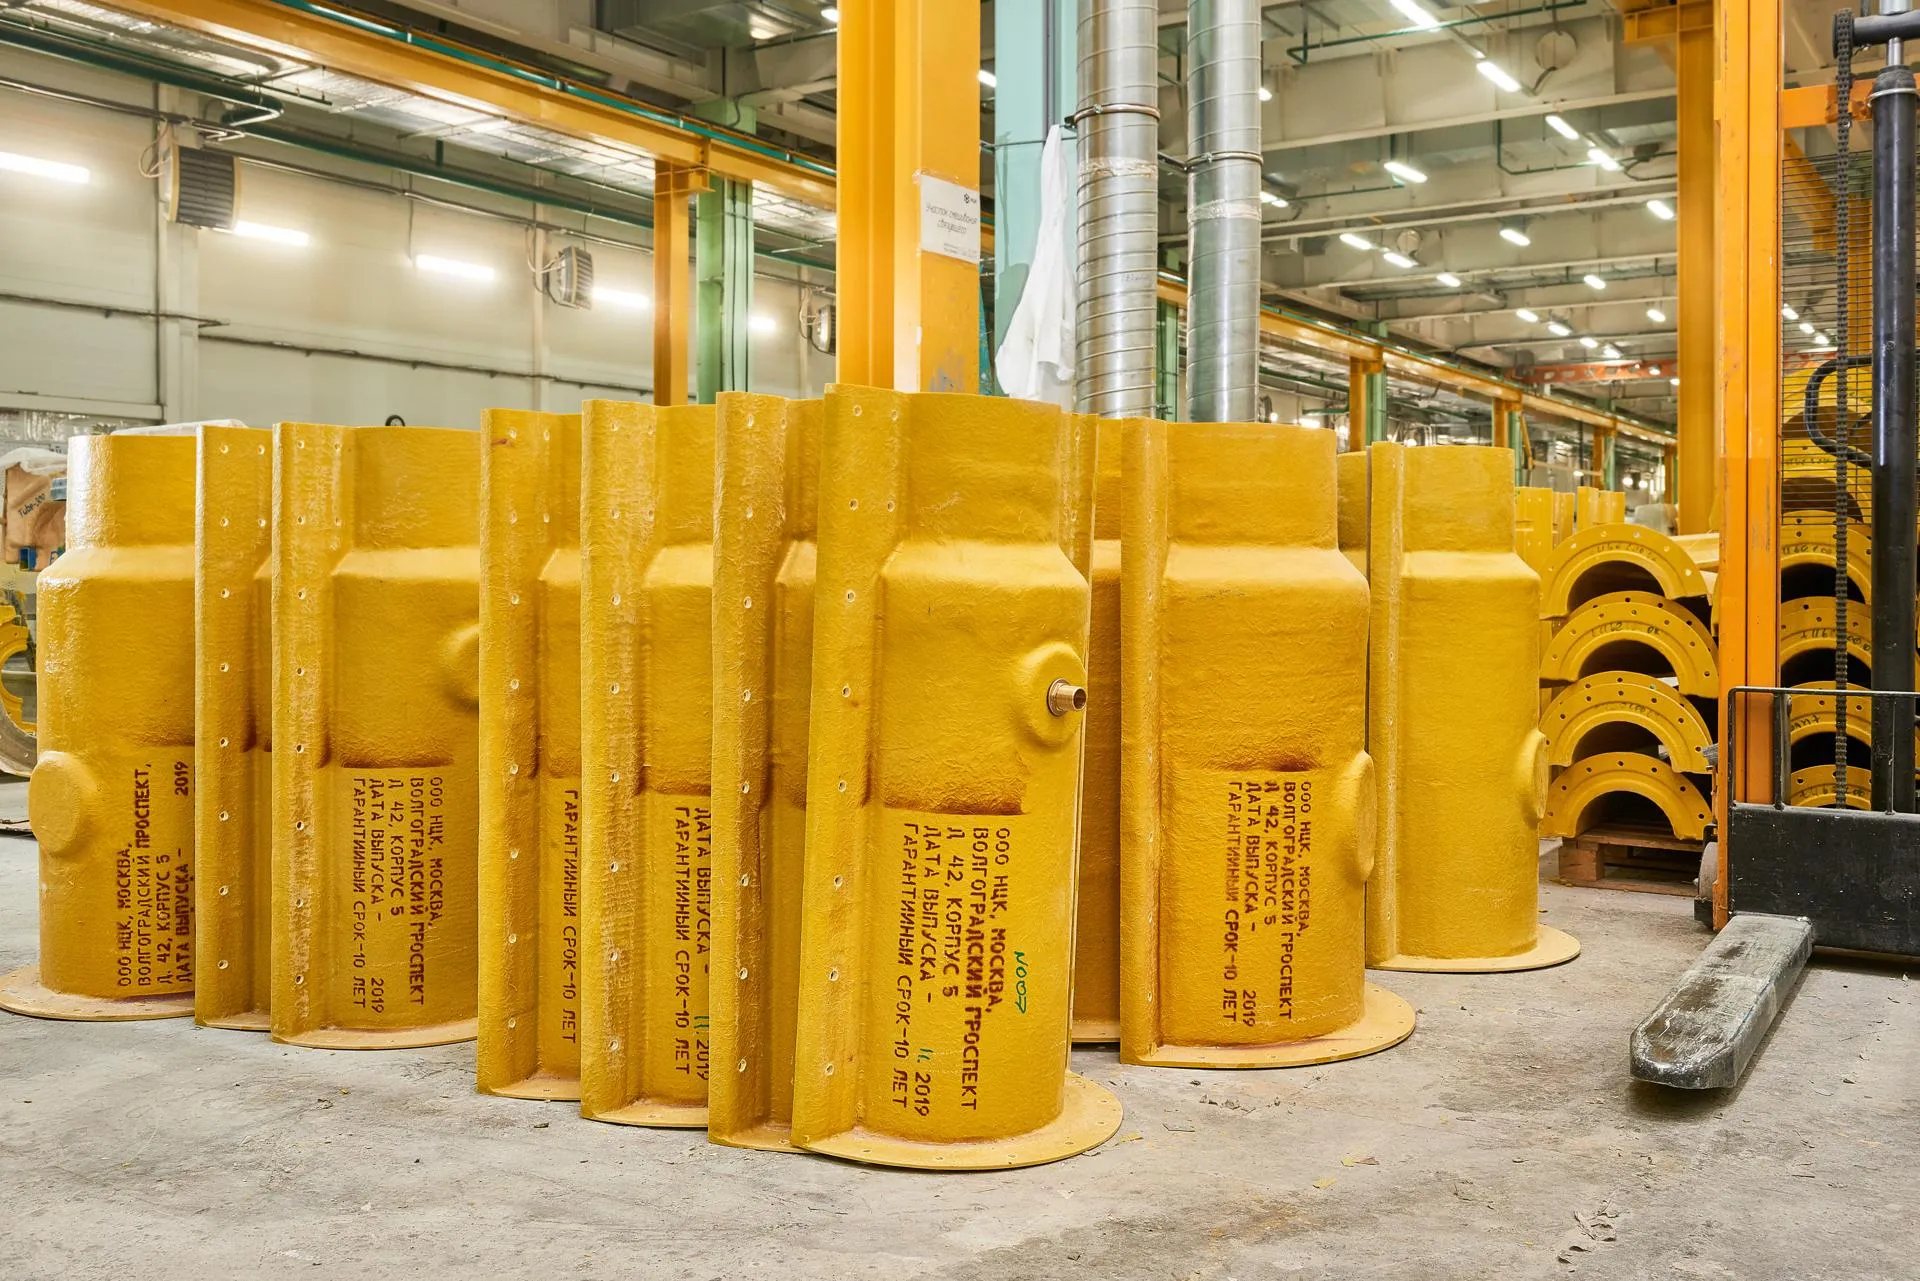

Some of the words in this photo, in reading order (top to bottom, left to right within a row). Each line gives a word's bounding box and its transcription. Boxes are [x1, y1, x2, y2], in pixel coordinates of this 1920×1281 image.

[174, 761, 189, 796] 2019
[430, 777, 443, 807] ООО
[1300, 781, 1312, 813] ООО
[134, 763, 152, 849] ПРОСПЕКТ,
[369, 779, 384, 821] ДАТА
[388, 802, 404, 827] 42,
[1246, 782, 1262, 826] ДАТА
[1264, 804, 1278, 833] 42,
[408, 778, 428, 915] ВОЛГОГРАДСКИЙ
[428, 815, 443, 850] НЦК,
[694, 807, 711, 858] ДАТА
[924, 826, 941, 878] ДАТА
[996, 828, 1010, 865] ООО
[1298, 821, 1312, 858] НЦК,
[156, 854, 170, 863] 5
[370, 830, 384, 904] ВЫПУСКА
[390, 835, 404, 898] КОРПУС
[944, 855, 963, 887] 42,
[1281, 782, 1298, 925] ВОЛГОГРАДСКИЙ
[117, 843, 133, 909] МОСКВА,
[428, 858, 443, 927] МОСКВА,
[1244, 835, 1260, 914] ВЫПУСКА
[1264, 841, 1278, 907] КОРПУС
[156, 872, 171, 931] КОРПУС
[175, 864, 189, 936] ВЫПУСКА
[390, 906, 404, 916] 5
[696, 867, 711, 955] ВЫПУСКА
[965, 828, 989, 999] ВОЛГОГРАДСКИЙ
[990, 875, 1008, 919] НЦК,
[1297, 866, 1310, 936] МОСКВА,
[118, 914, 134, 951] НЦК,
[132, 855, 151, 986] ВОЛГОГРАДСКИЙ
[920, 889, 939, 982] ВЫПУСКА
[943, 898, 962, 976] КОРПУС
[1264, 915, 1276, 925] 5
[157, 938, 173, 963] 42,
[176, 943, 192, 982] ДАТА
[986, 928, 1006, 1013] МОСКВА,
[117, 957, 132, 987] ООО
[353, 976, 366, 1008] ЛЕТ
[942, 985, 958, 998] 5
[370, 978, 384, 1013] 2019
[1223, 988, 1237, 1023] ЛЕТ
[1242, 989, 1257, 1027] 2019
[561, 1008, 576, 1043] ЛЕТ
[675, 1038, 690, 1074] ЛЕТ
[892, 1069, 908, 1108] ЛЕТ
[914, 1072, 931, 1117] 2019
